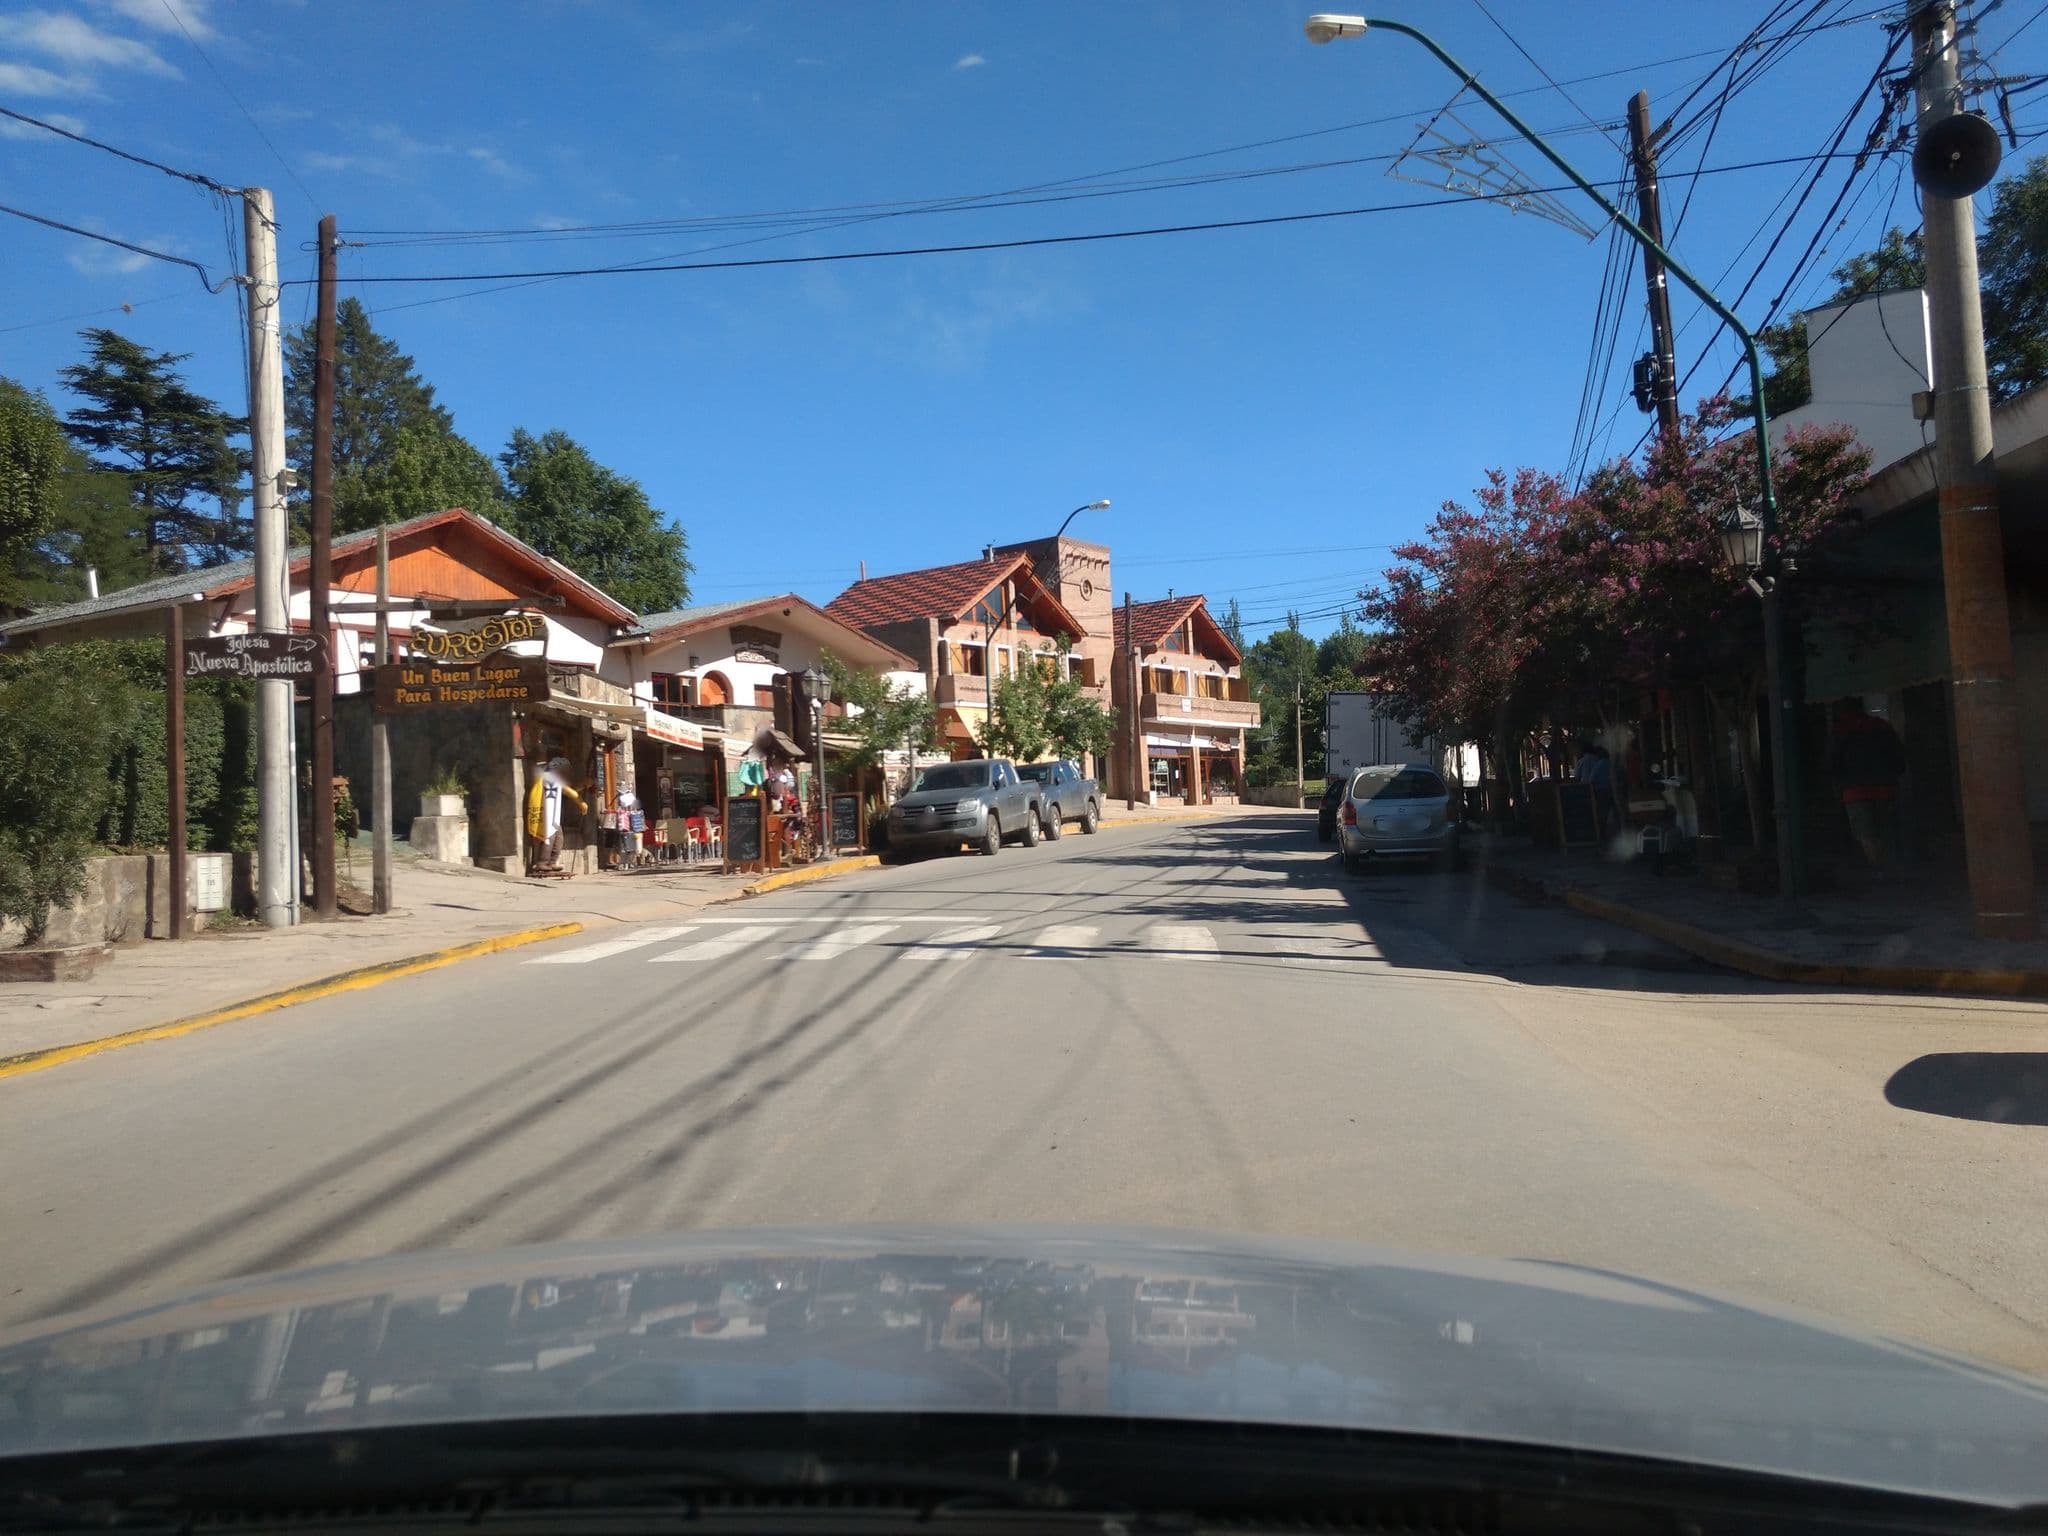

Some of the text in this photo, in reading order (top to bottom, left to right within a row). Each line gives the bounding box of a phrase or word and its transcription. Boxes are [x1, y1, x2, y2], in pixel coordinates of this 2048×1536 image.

[226, 635, 270, 654] Iglesia
[411, 617, 545, 658] EUROSTOP
[186, 651, 313, 678] Nueva Apostólica
[401, 666, 521, 685] Un Buen Lugar
[395, 684, 529, 704] Para Hospedarse
